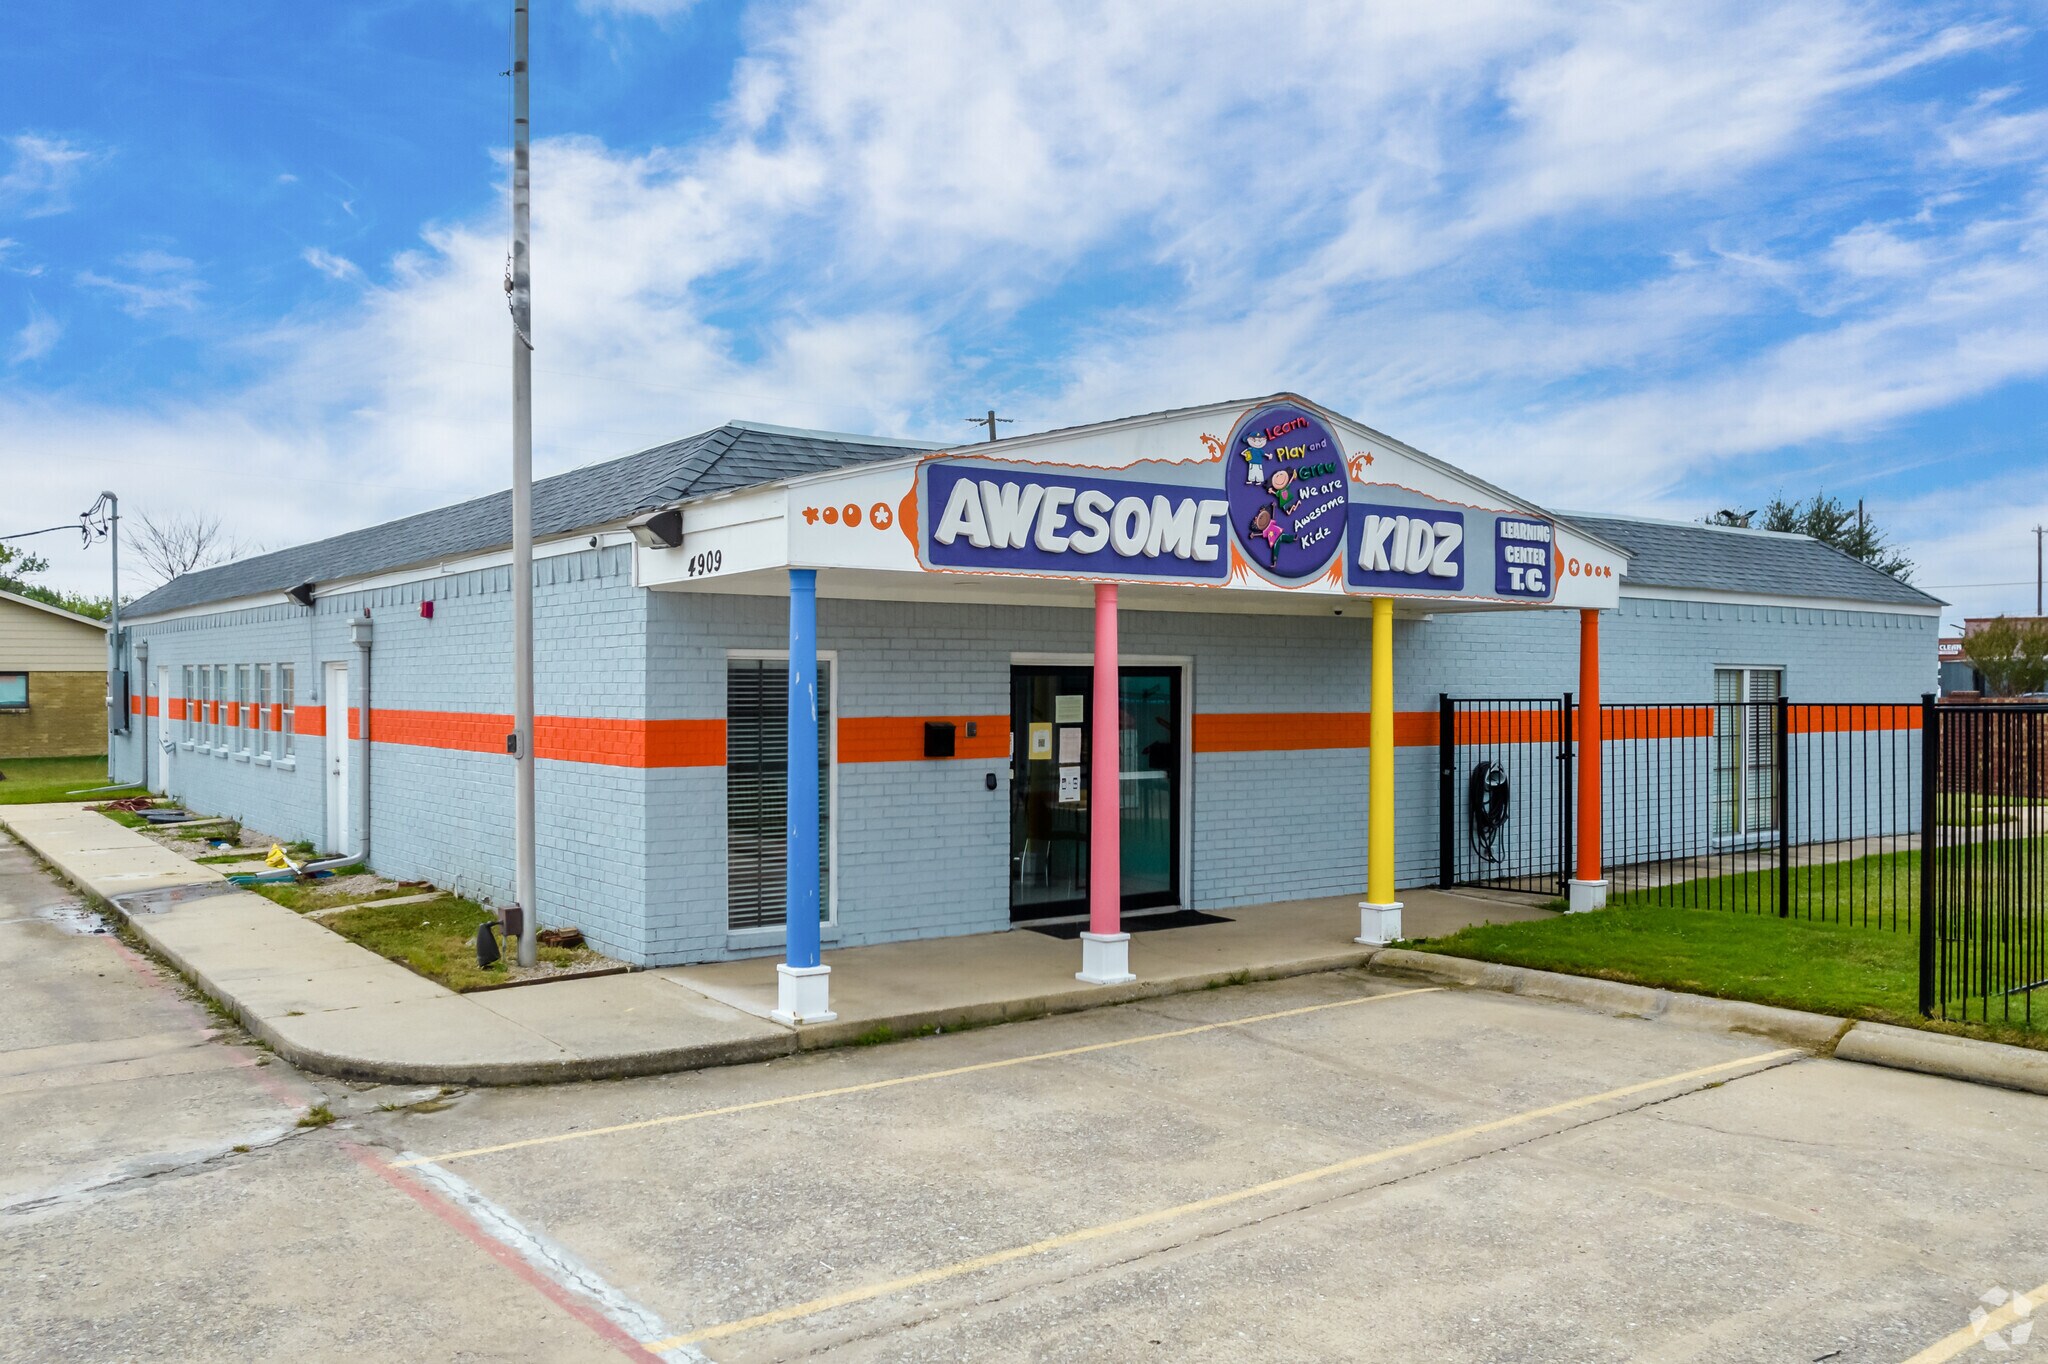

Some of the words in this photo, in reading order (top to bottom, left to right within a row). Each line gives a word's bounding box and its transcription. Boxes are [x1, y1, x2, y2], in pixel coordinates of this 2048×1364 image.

[1266, 417, 1309, 440] Learn,
[1276, 443, 1306, 463] Play
[1309, 438, 1327, 451] and
[1299, 462, 1336, 480] Grow
[1299, 486, 1318, 500] We
[1321, 479, 1343, 494] are
[1294, 496, 1344, 532] Awesome
[934, 478, 1229, 562] AWESOME
[1358, 514, 1463, 578] KIDZ
[1301, 527, 1330, 549] Kidz
[1500, 521, 1550, 542] LEARNING
[688, 550, 721, 577] 4909
[1504, 545, 1546, 566] CENTER
[1507, 567, 1546, 592] T.C.
